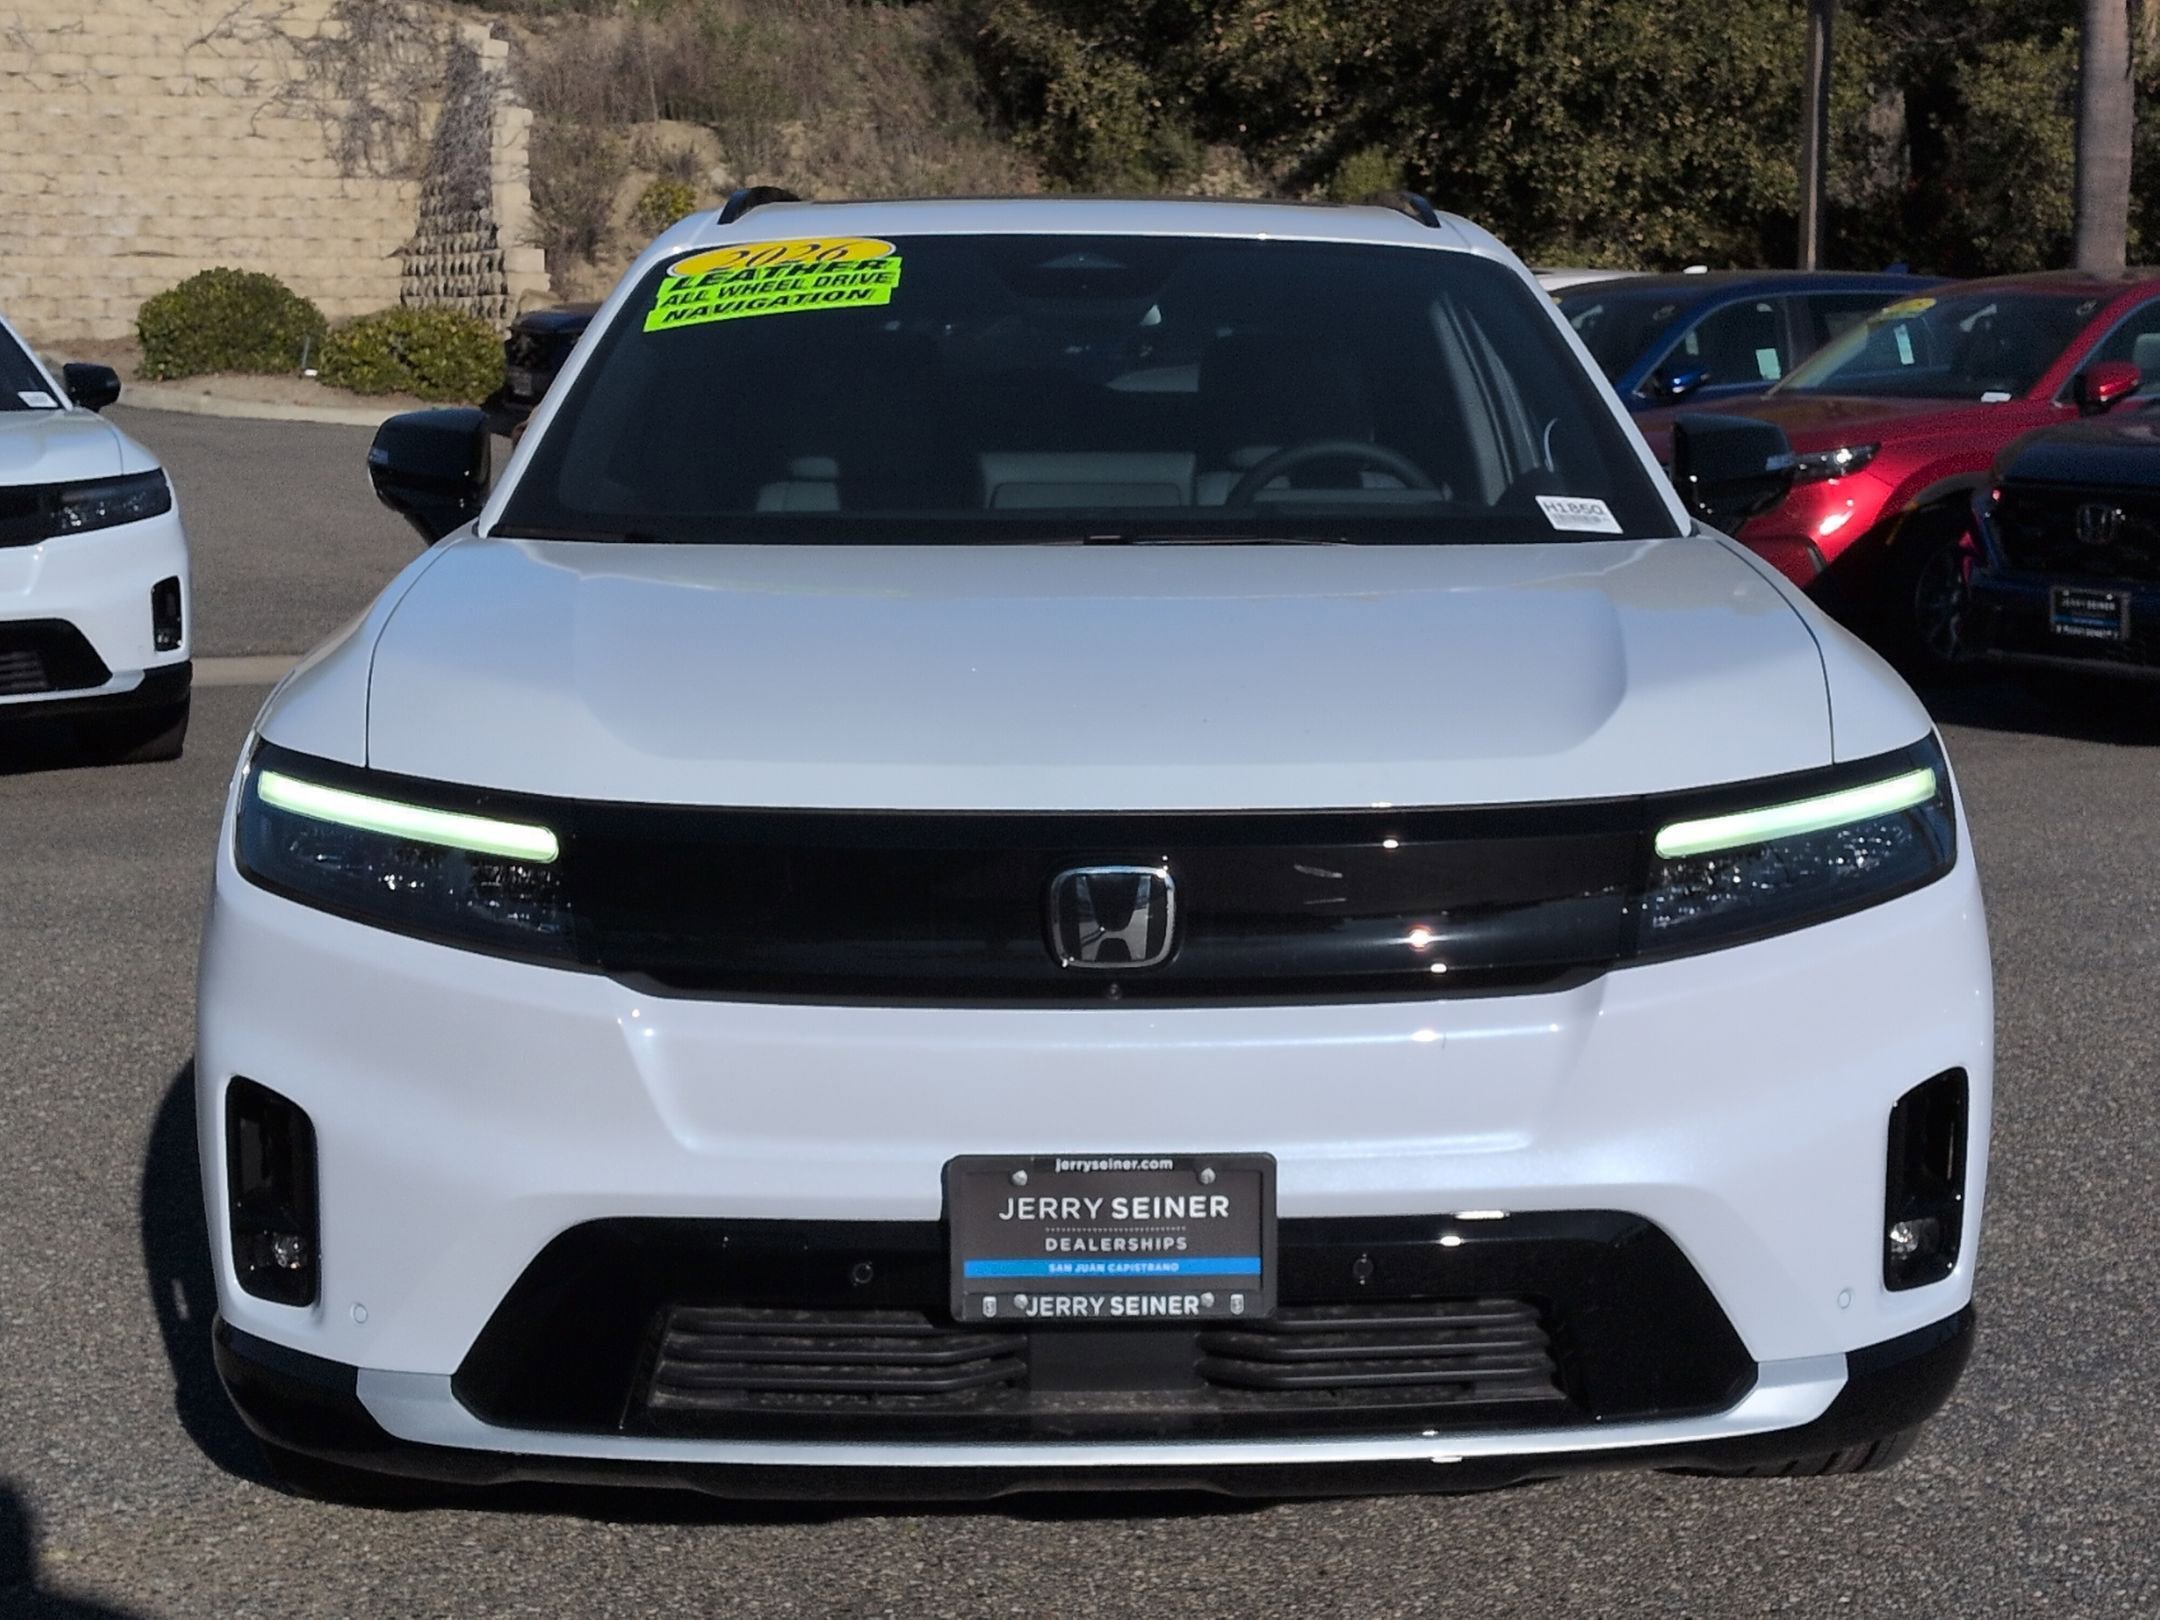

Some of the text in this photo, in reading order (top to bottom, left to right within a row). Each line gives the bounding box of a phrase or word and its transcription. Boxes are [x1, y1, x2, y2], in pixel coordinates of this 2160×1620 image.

[661, 271, 894, 307] ALL WHEEL DRIVE
[662, 288, 874, 322] NAVIGATION
[1055, 1158, 1173, 1173] jerryseiner.com
[999, 1195, 1229, 1220] JERRY SEINER
[1045, 1236, 1188, 1252] DEALERSHIPS
[1048, 1262, 1180, 1273] SAN JUAN CAPISTRANO
[1026, 1295, 1200, 1317] JERRY SEINER
